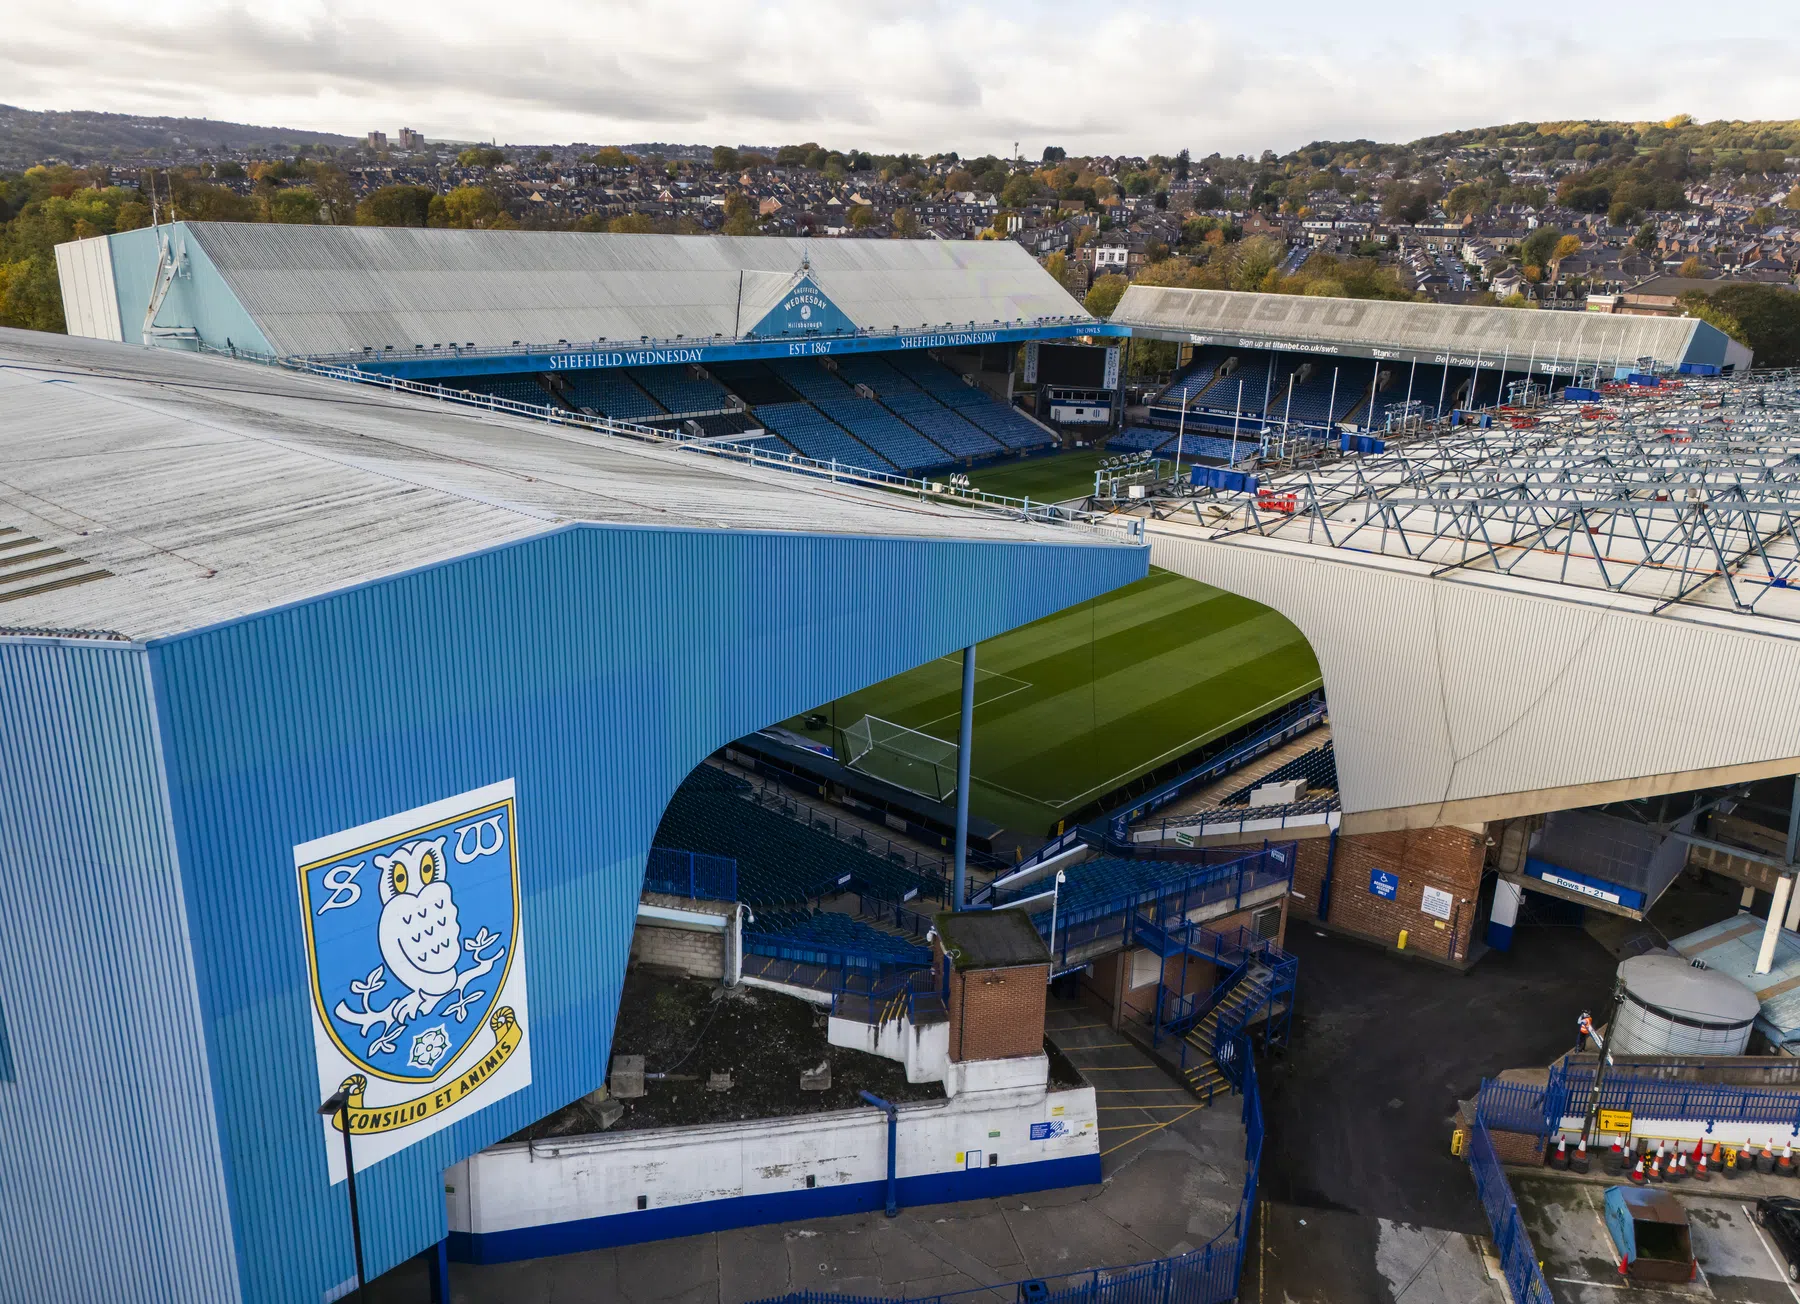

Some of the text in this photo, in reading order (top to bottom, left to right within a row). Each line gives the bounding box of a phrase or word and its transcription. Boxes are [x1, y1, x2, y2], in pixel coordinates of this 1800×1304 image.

[794, 287, 818, 295] SHEFFIELD
[784, 295, 827, 311] WEDNESDAY
[789, 341, 832, 355] EST. 1867
[901, 332, 997, 348] SHEFFIELD WEDNESDAY
[1238, 338, 1253, 348] Sign
[1254, 341, 1263, 349] up
[1272, 342, 1339, 354] titanbet.co.uk/swfc
[550, 349, 703, 369] SHEFFIELD WEDNESDAY
[1371, 348, 1400, 359] Titanbet
[1449, 356, 1477, 368] in-play
[1556, 877, 1579, 890] Rows
[1593, 889, 1604, 898] 21
[349, 1041, 512, 1130] CONSILIO ET ANIMIS
